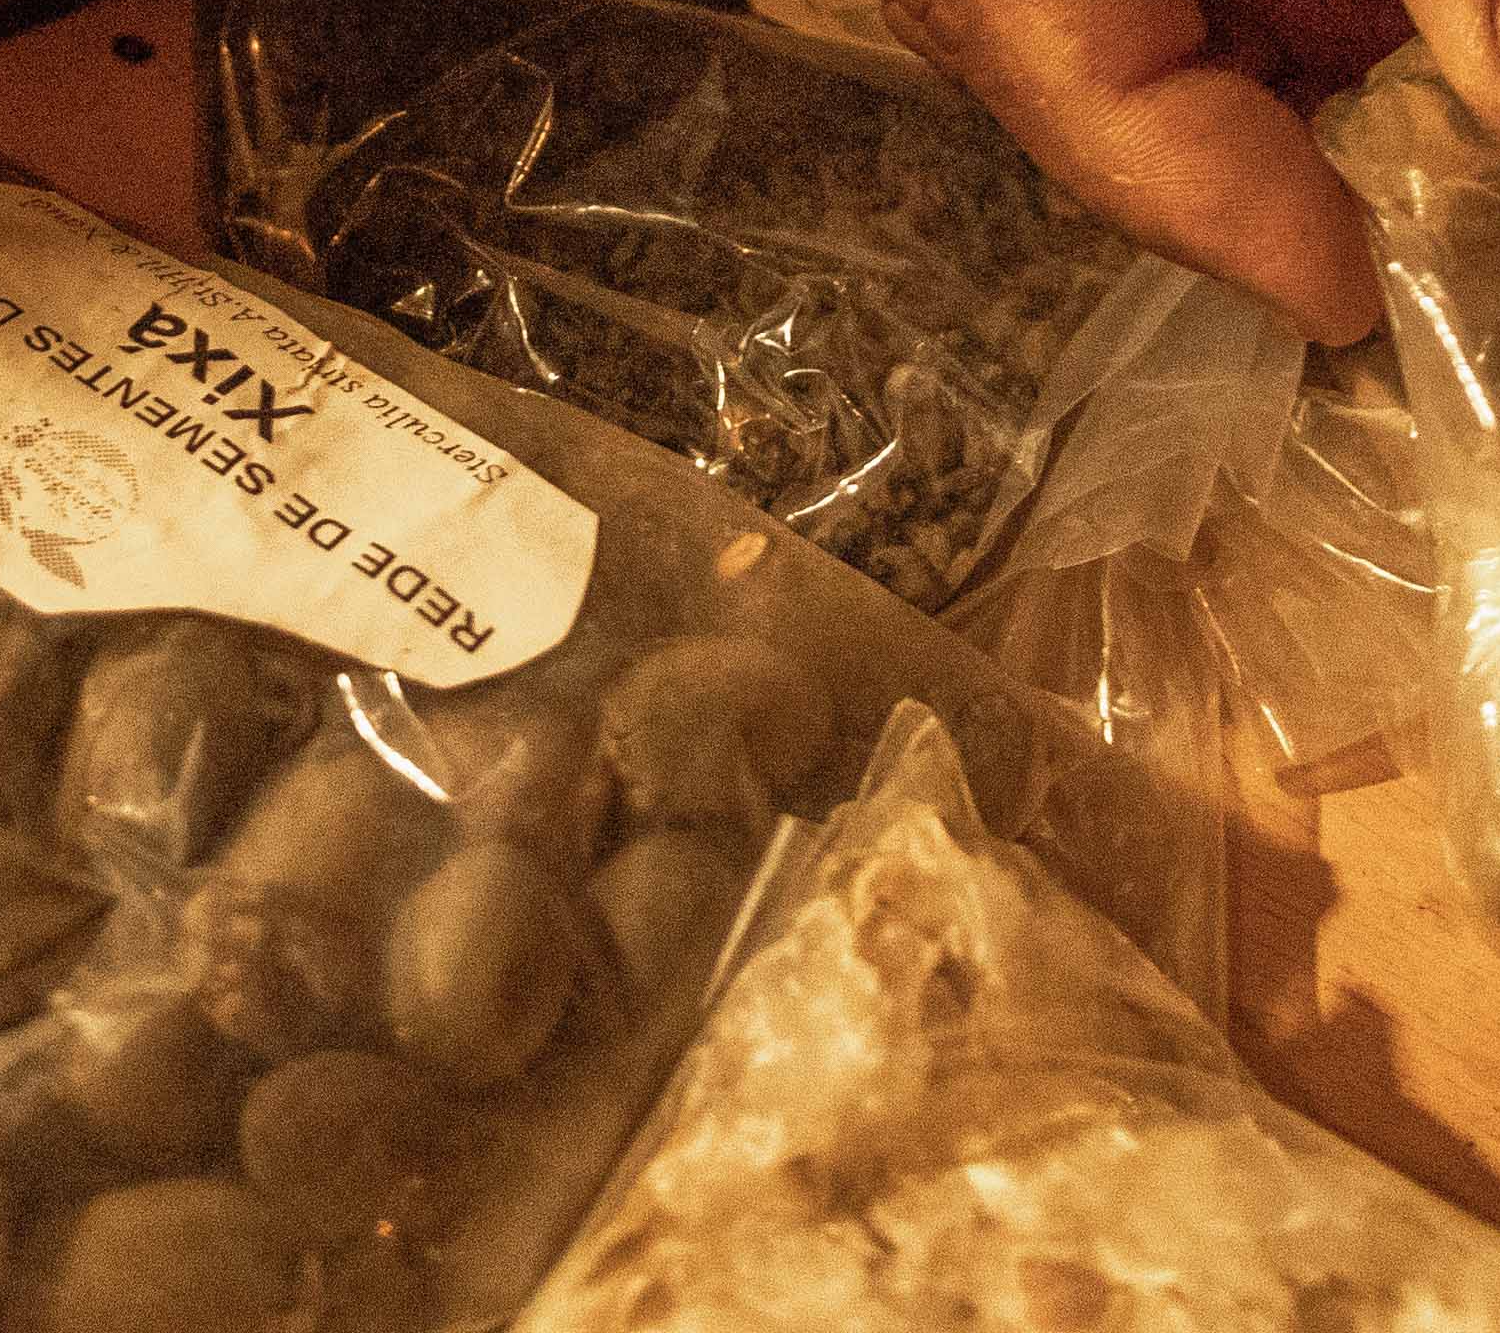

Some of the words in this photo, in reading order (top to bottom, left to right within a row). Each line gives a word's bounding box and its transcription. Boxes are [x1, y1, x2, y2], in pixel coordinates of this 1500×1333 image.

[23, 323, 276, 495] SEMENTES
[119, 301, 314, 443] Xixá
[262, 325, 356, 392] striata
[363, 393, 509, 486] Sterculia
[275, 493, 351, 551] DE
[352, 543, 494, 653] REDE
